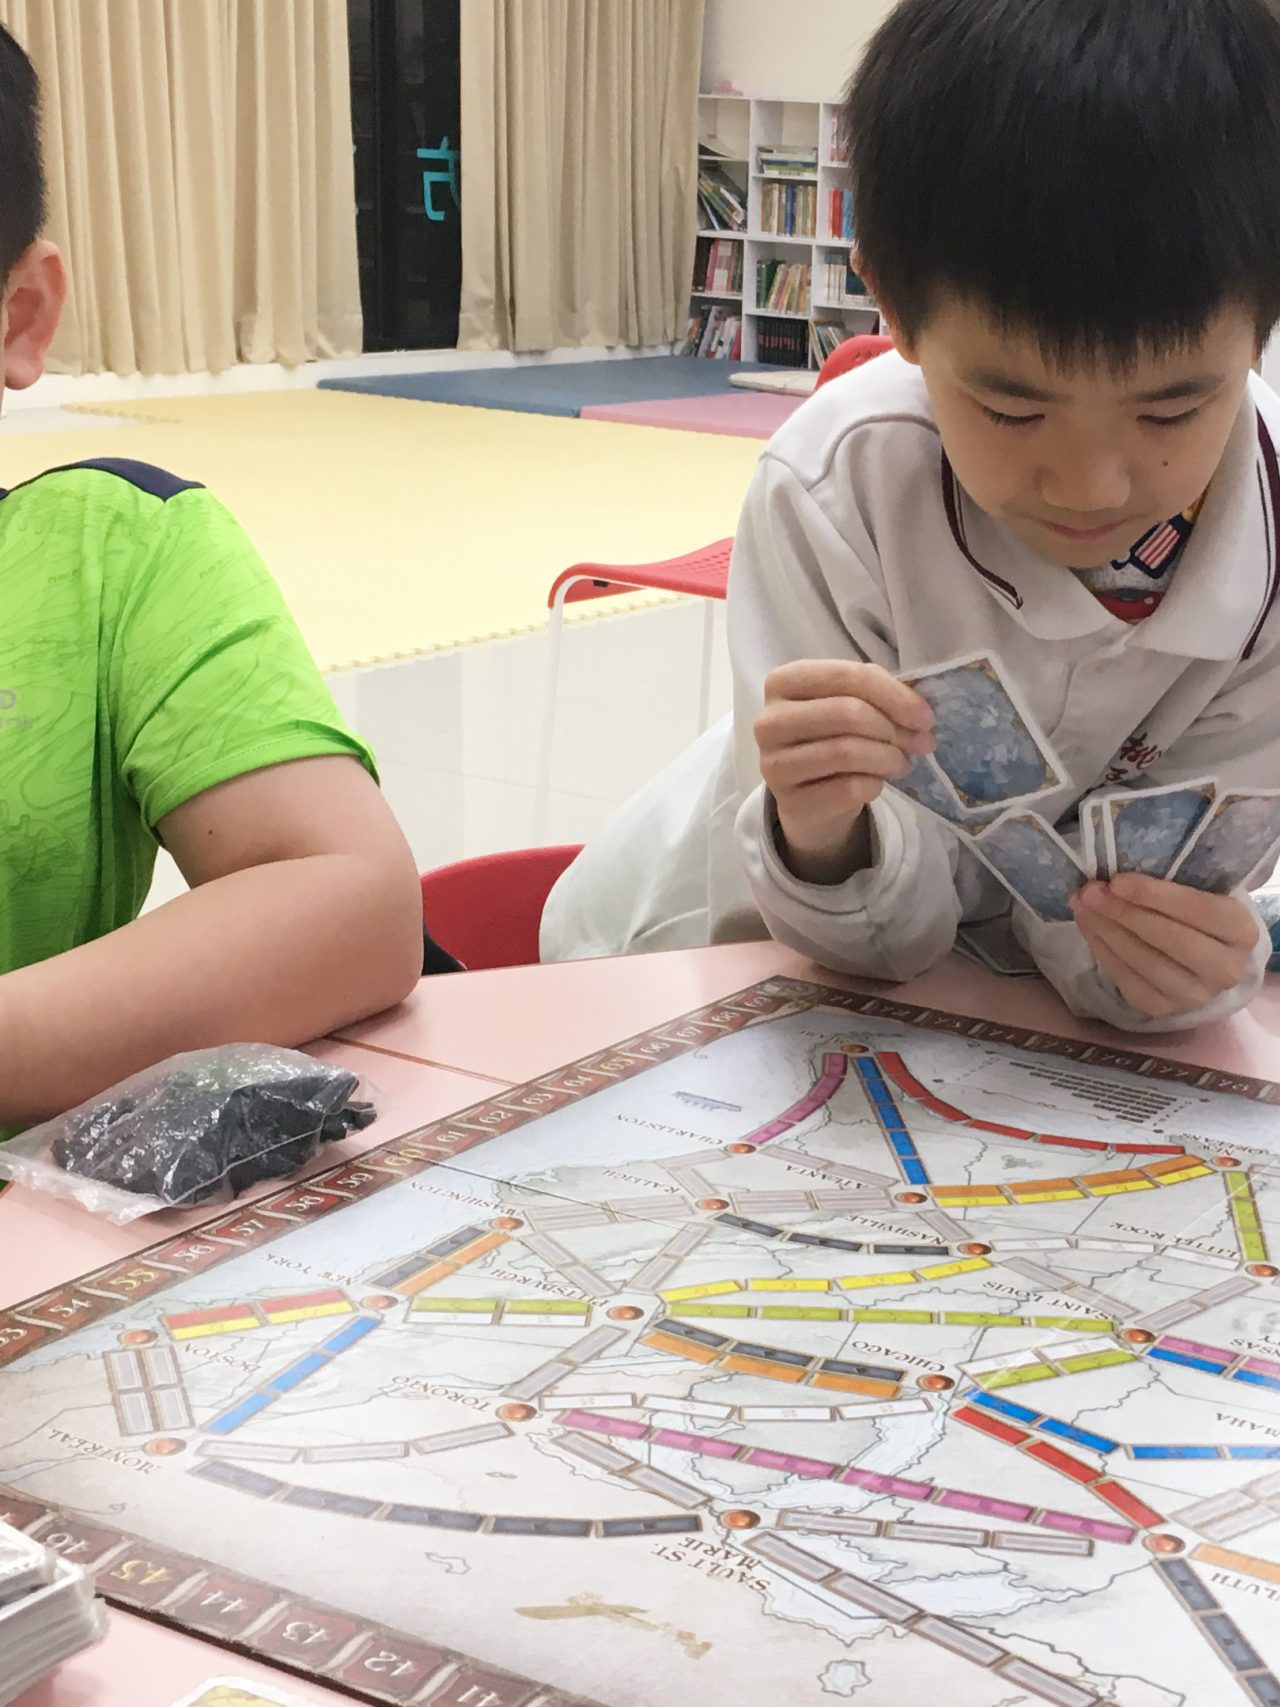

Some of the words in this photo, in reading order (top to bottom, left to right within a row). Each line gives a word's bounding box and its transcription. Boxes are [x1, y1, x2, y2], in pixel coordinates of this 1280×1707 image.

[563, 1074, 593, 1088] 64
[521, 1092, 553, 1107] 63
[478, 1110, 512, 1125] 62
[614, 1113, 723, 1146] CHARLESTON
[436, 1129, 468, 1145] 61
[383, 1148, 426, 1168] 60
[337, 1171, 375, 1189] 59
[601, 1168, 680, 1196] RALEIGH
[783, 1163, 870, 1190] ATLANTA
[284, 1193, 326, 1213] 58
[406, 1179, 520, 1218] WASHINGTON
[230, 1218, 268, 1237] 57
[842, 1214, 947, 1247] NASHVILLE
[1108, 1221, 1166, 1241] ROCK
[172, 1242, 216, 1261] 56
[259, 1251, 314, 1274] YORK
[108, 1267, 161, 1292] 55
[317, 1270, 358, 1287] NEW
[488, 1267, 610, 1309] PITTSBURGH
[981, 1279, 1044, 1303] LOUIS
[48, 1297, 92, 1319] 54
[1044, 1293, 1114, 1321] SAINT
[181, 1341, 263, 1374] BOSTON
[851, 1340, 945, 1373] CHICAGO
[390, 1374, 493, 1413] TORONTO
[649, 1542, 687, 1564] ST.
[675, 1535, 761, 1571] MARIE
[109, 1558, 175, 1586] 45
[687, 1557, 772, 1592] SAULT
[199, 1589, 248, 1615] 44
[281, 1620, 333, 1646] 43
[363, 1649, 419, 1677] 42
[456, 1684, 504, 1707] 41
